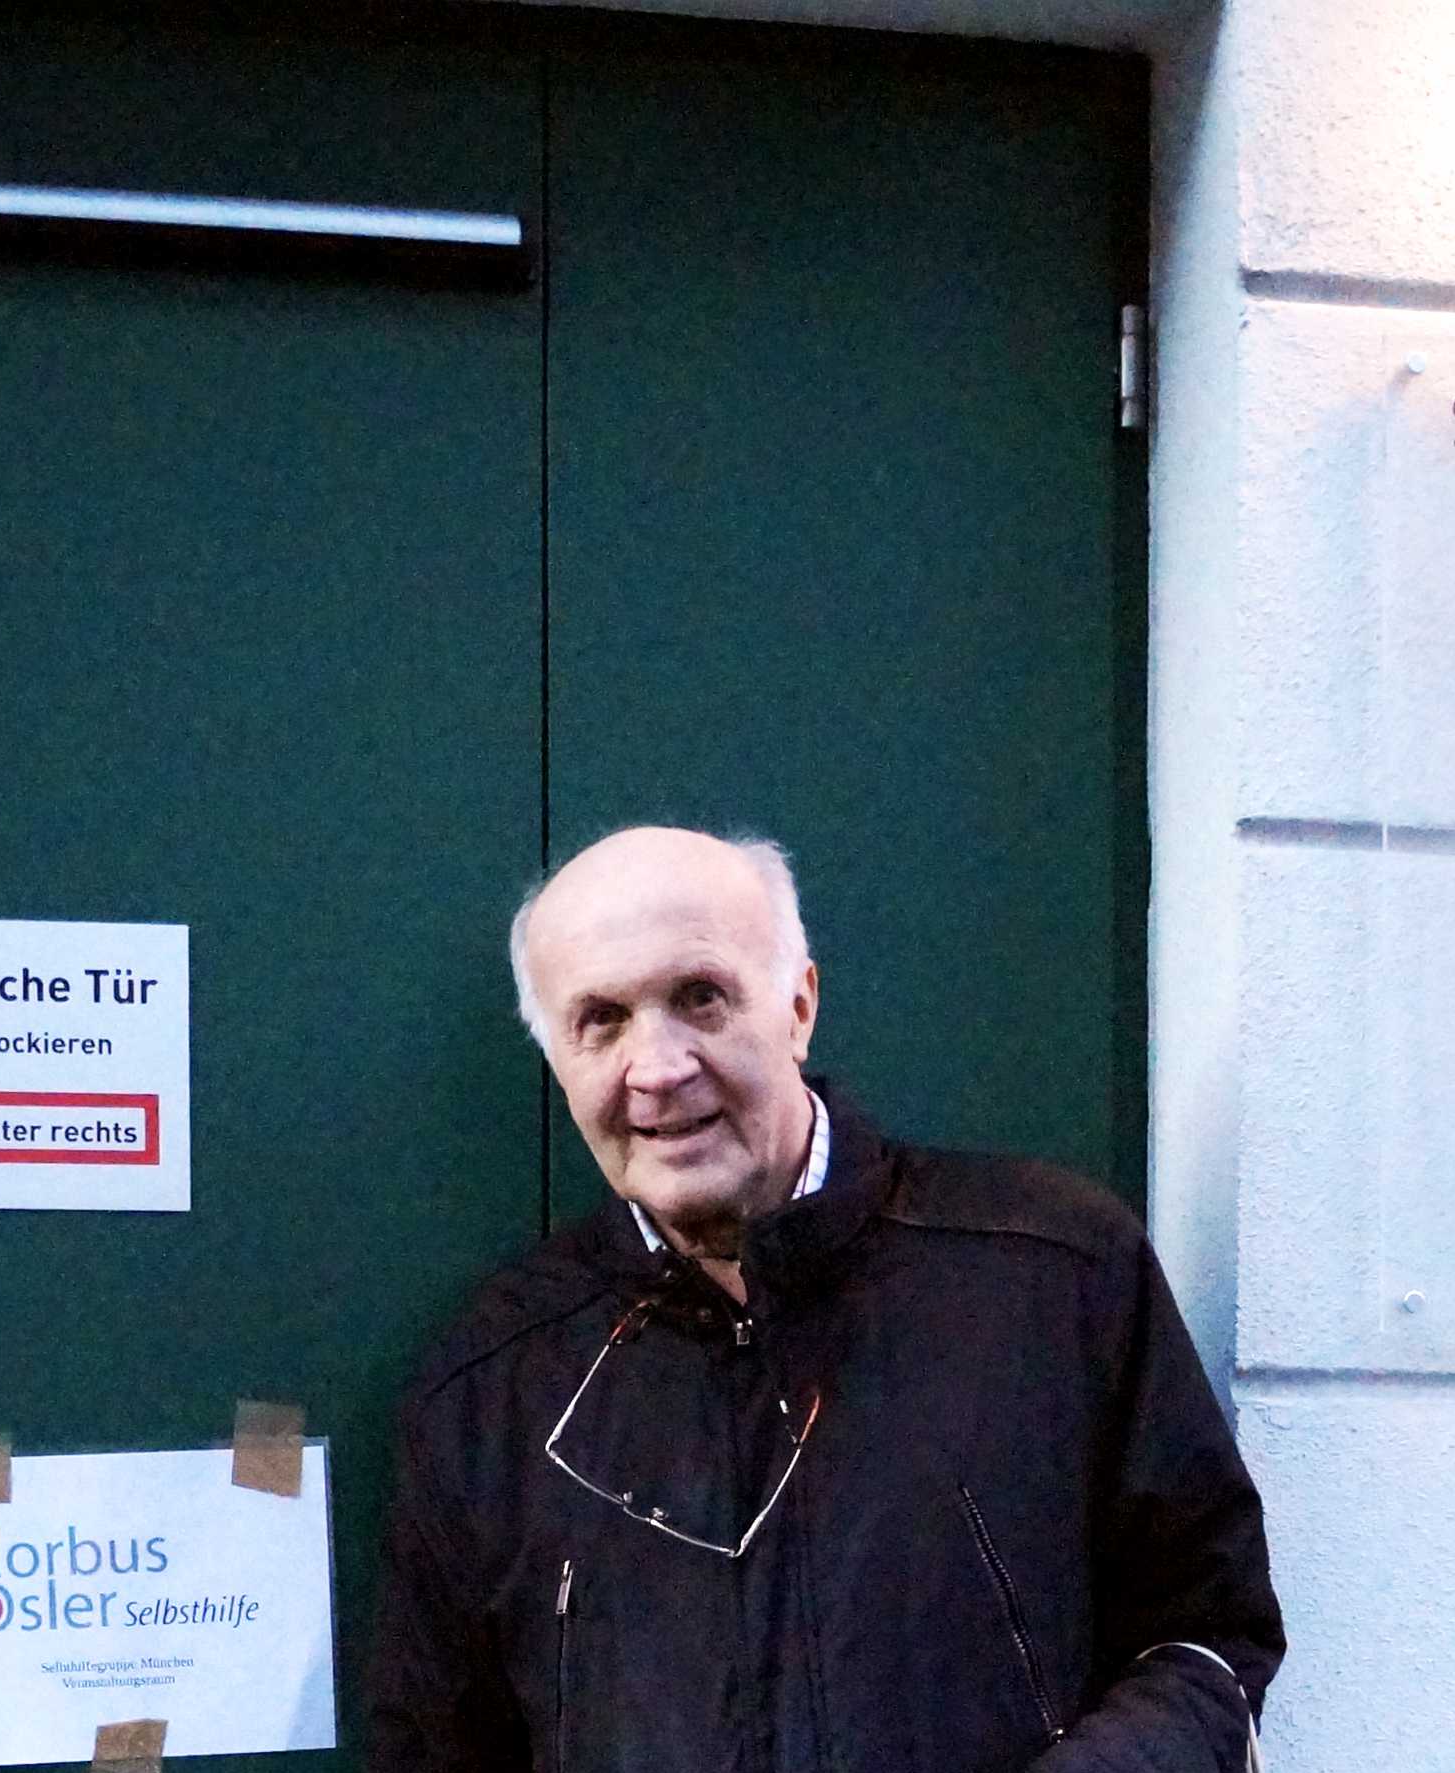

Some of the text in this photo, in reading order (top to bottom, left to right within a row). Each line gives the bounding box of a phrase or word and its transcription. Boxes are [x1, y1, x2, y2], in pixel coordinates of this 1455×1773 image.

[85, 968, 158, 1005] Tür
[51, 1120, 138, 1144] rechts
[124, 1594, 260, 1628] Selbsthilfe
[140, 1657, 194, 1669] München
